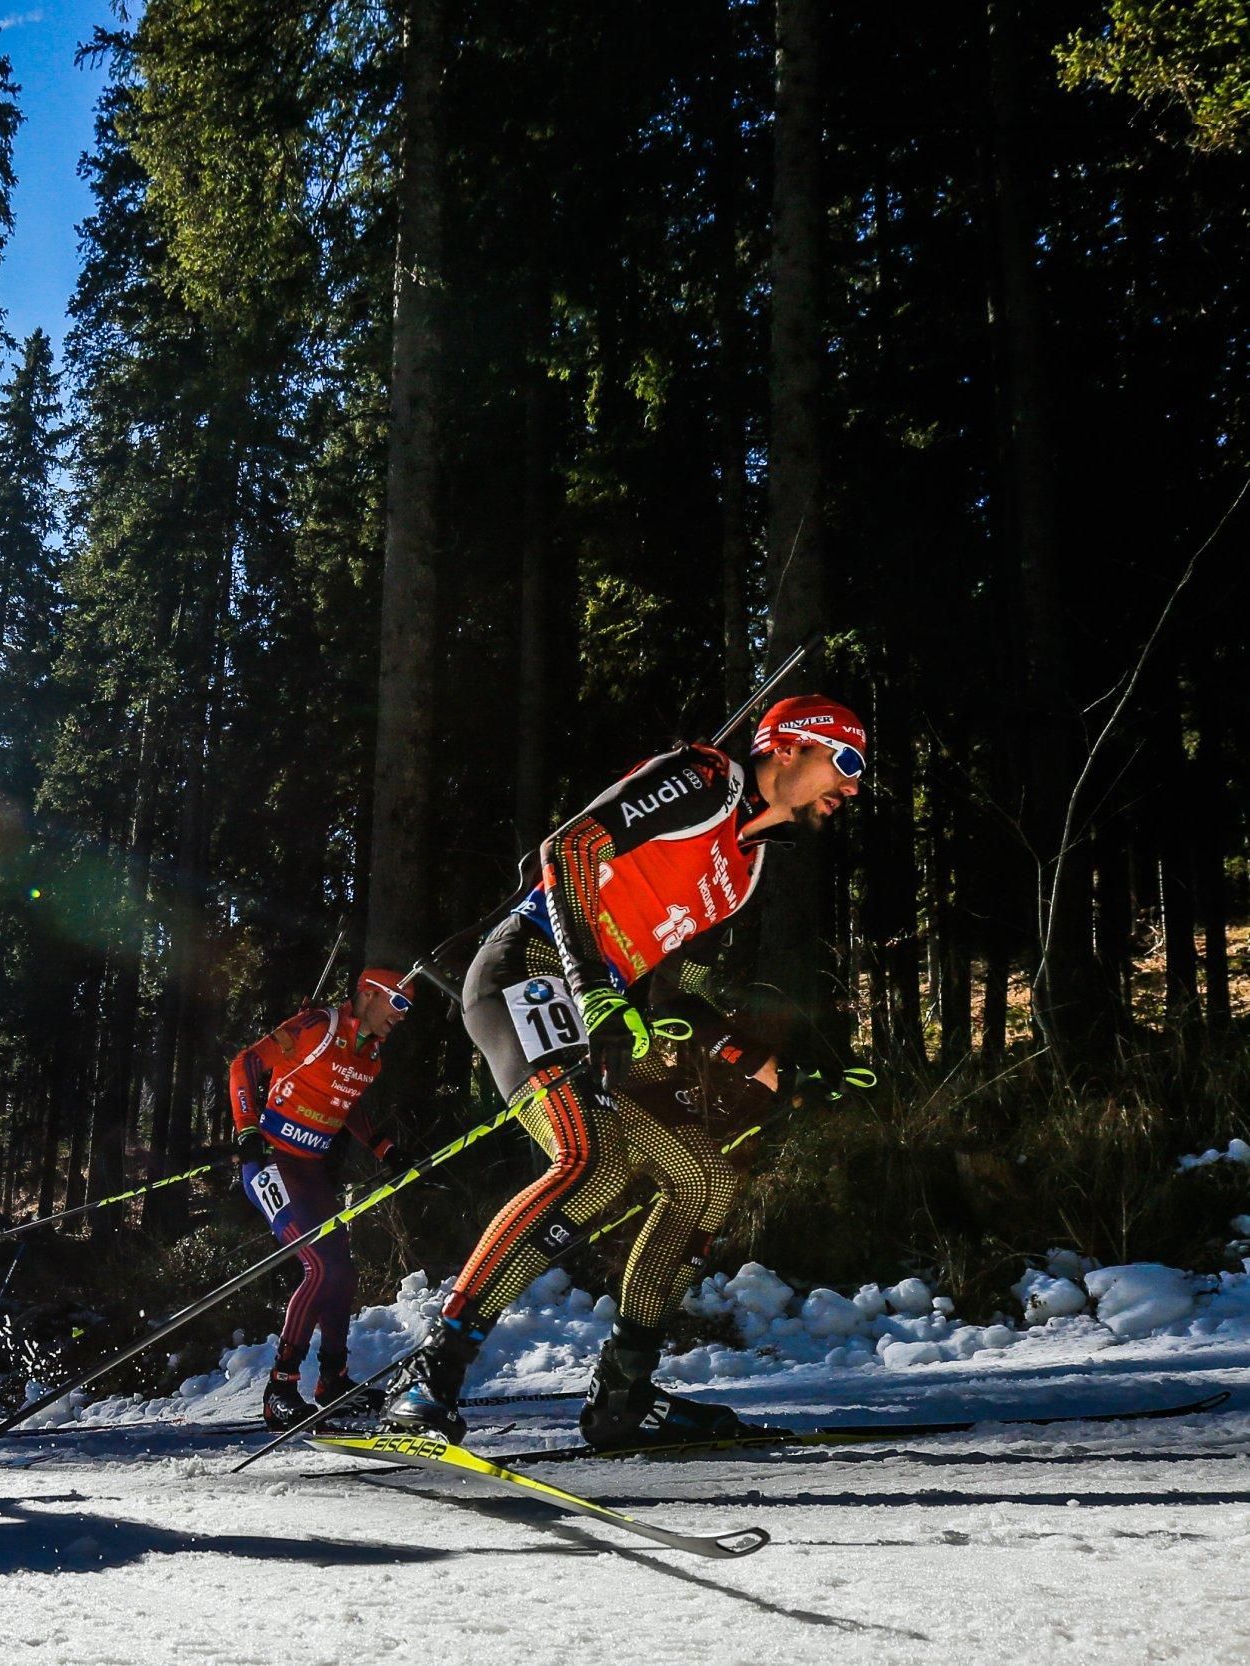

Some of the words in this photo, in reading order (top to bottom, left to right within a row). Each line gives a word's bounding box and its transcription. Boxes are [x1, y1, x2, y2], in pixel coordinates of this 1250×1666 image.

[620, 776, 688, 828] Audi
[723, 775, 741, 813] JOKA
[526, 1002, 580, 1052] 19
[280, 1122, 322, 1148] BMW
[262, 1182, 284, 1216] 18
[372, 1437, 447, 1460] FISCHER
